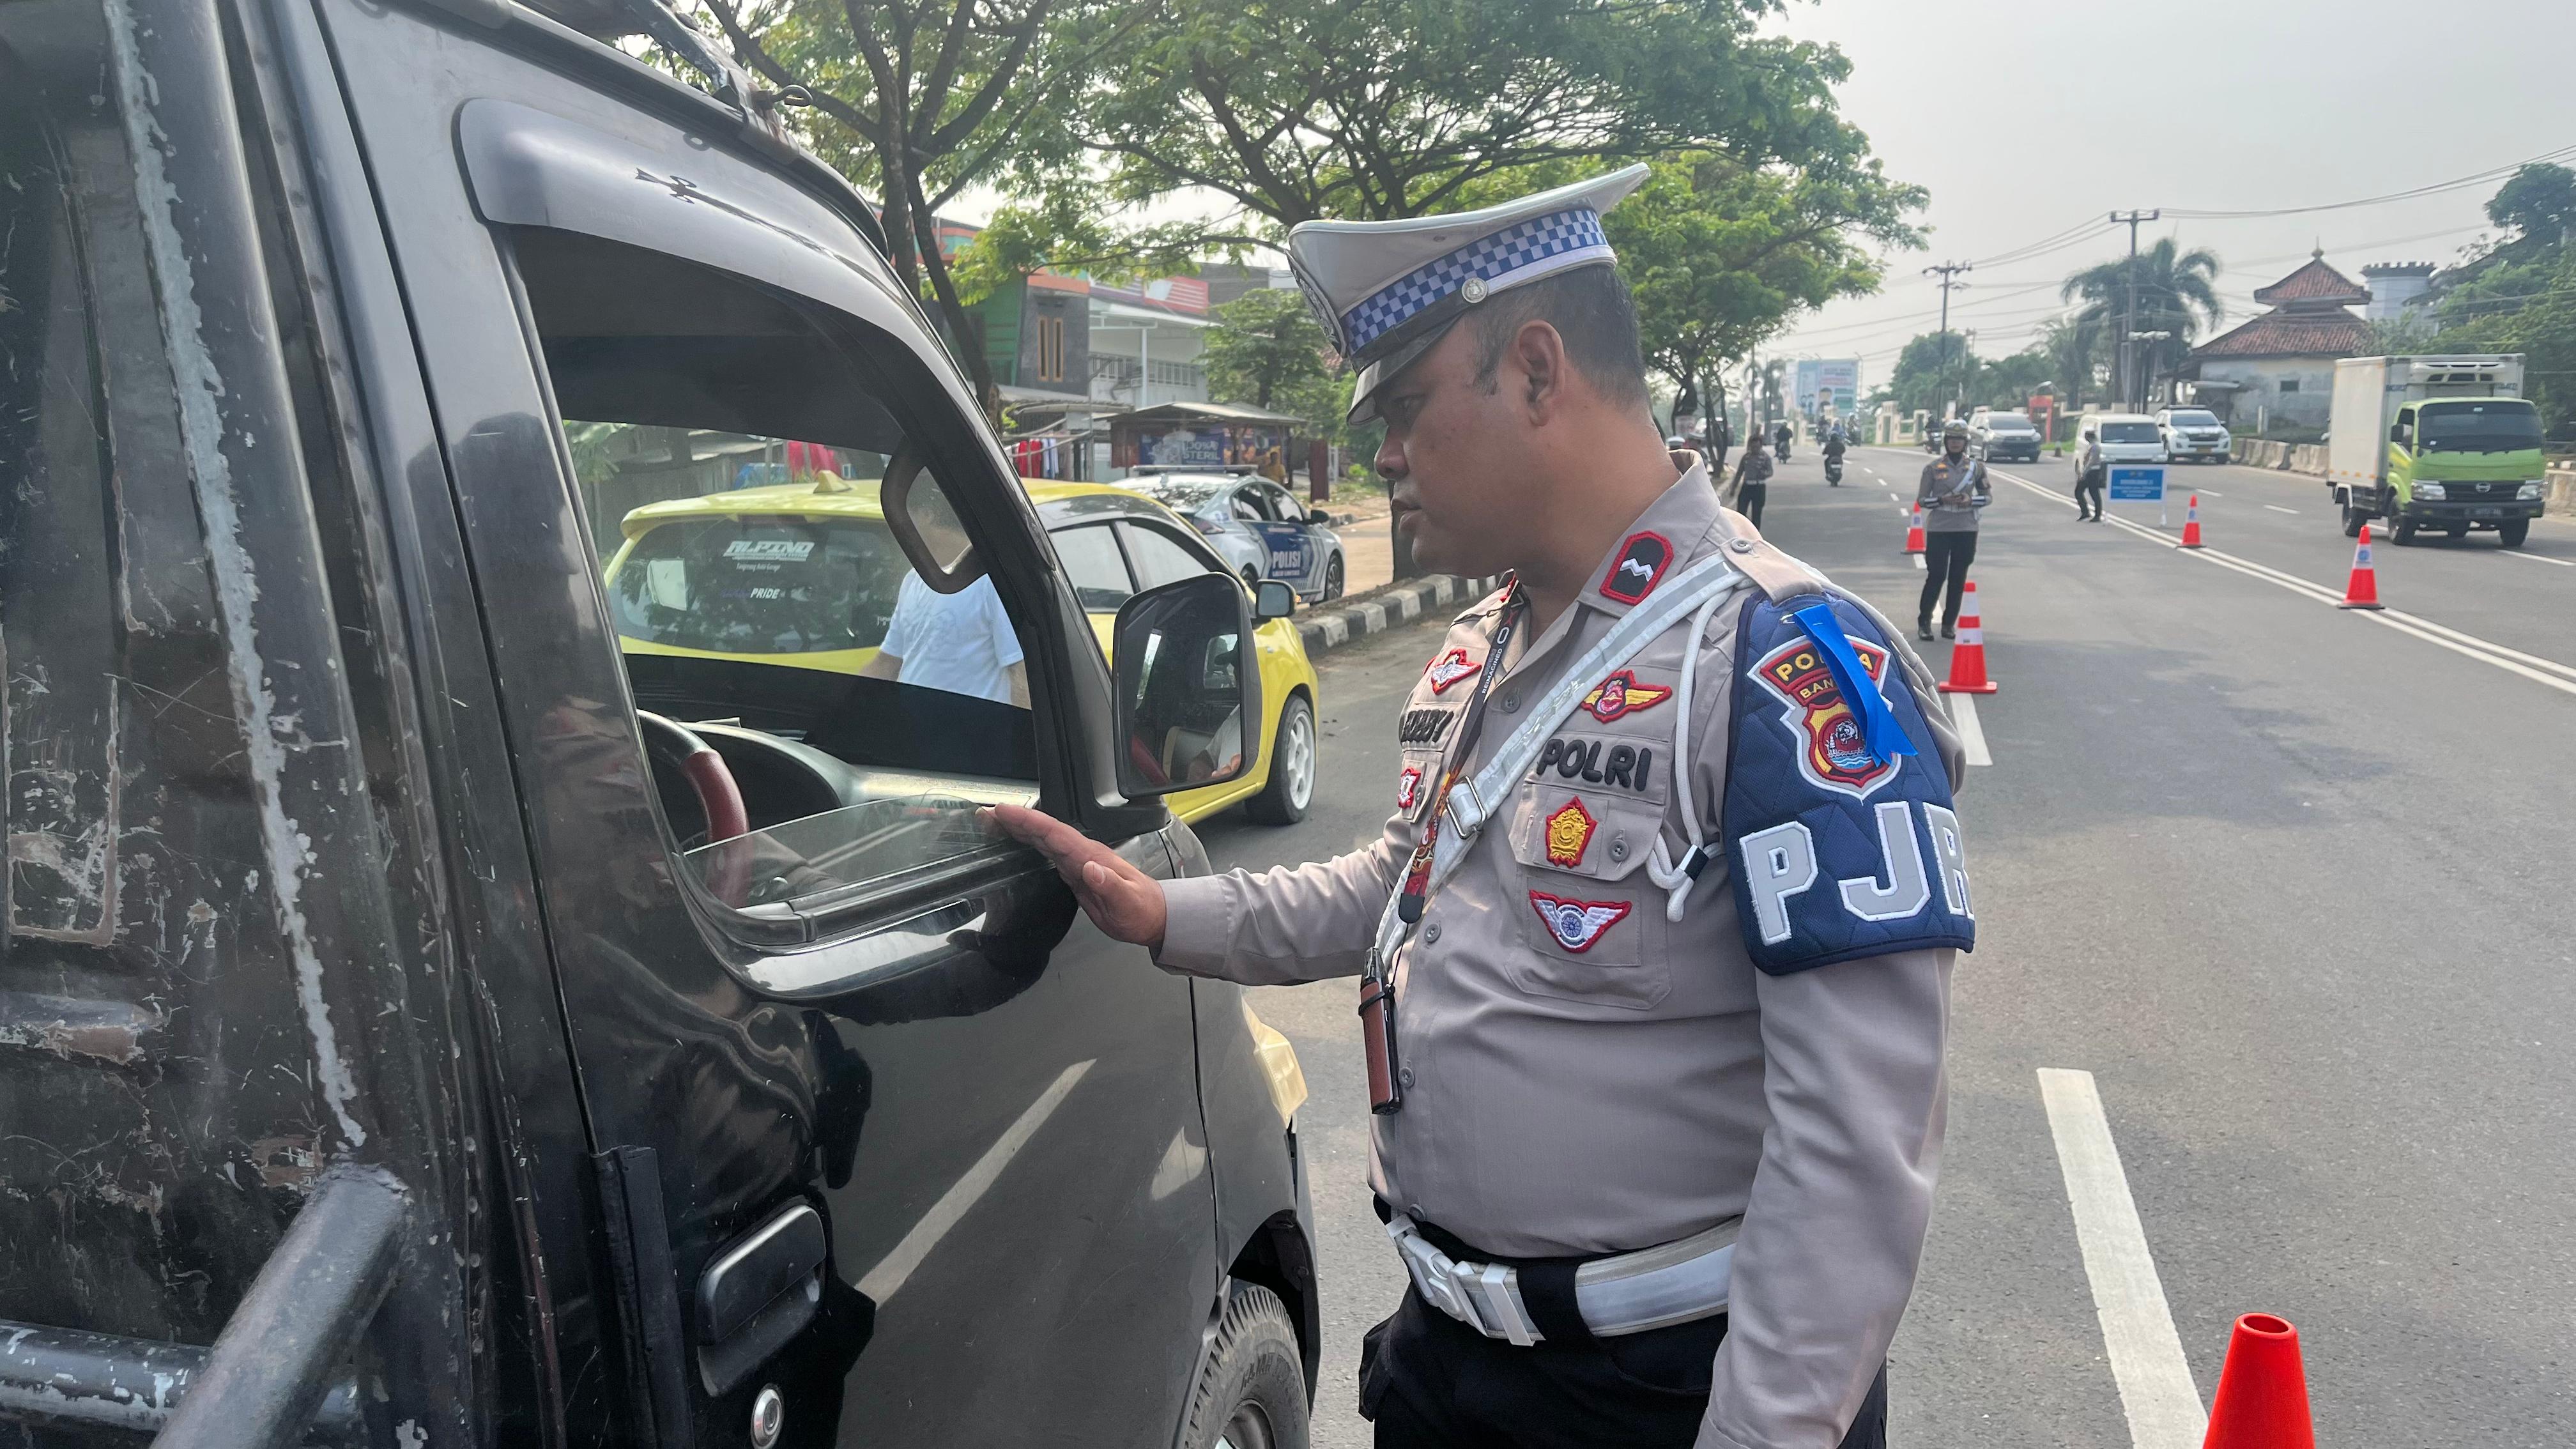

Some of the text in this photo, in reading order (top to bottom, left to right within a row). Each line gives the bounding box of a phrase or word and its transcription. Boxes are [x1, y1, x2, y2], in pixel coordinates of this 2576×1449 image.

[1183, 451, 1221, 461] STERIL
[1272, 551, 1301, 569] POLISI
[750, 587, 780, 599] PRIDE
[1482, 648, 1503, 694] REIMAGINED
[1775, 653, 1873, 682] POA
[1536, 739, 1652, 792] POLRI
[1739, 801, 1975, 946] PJR
